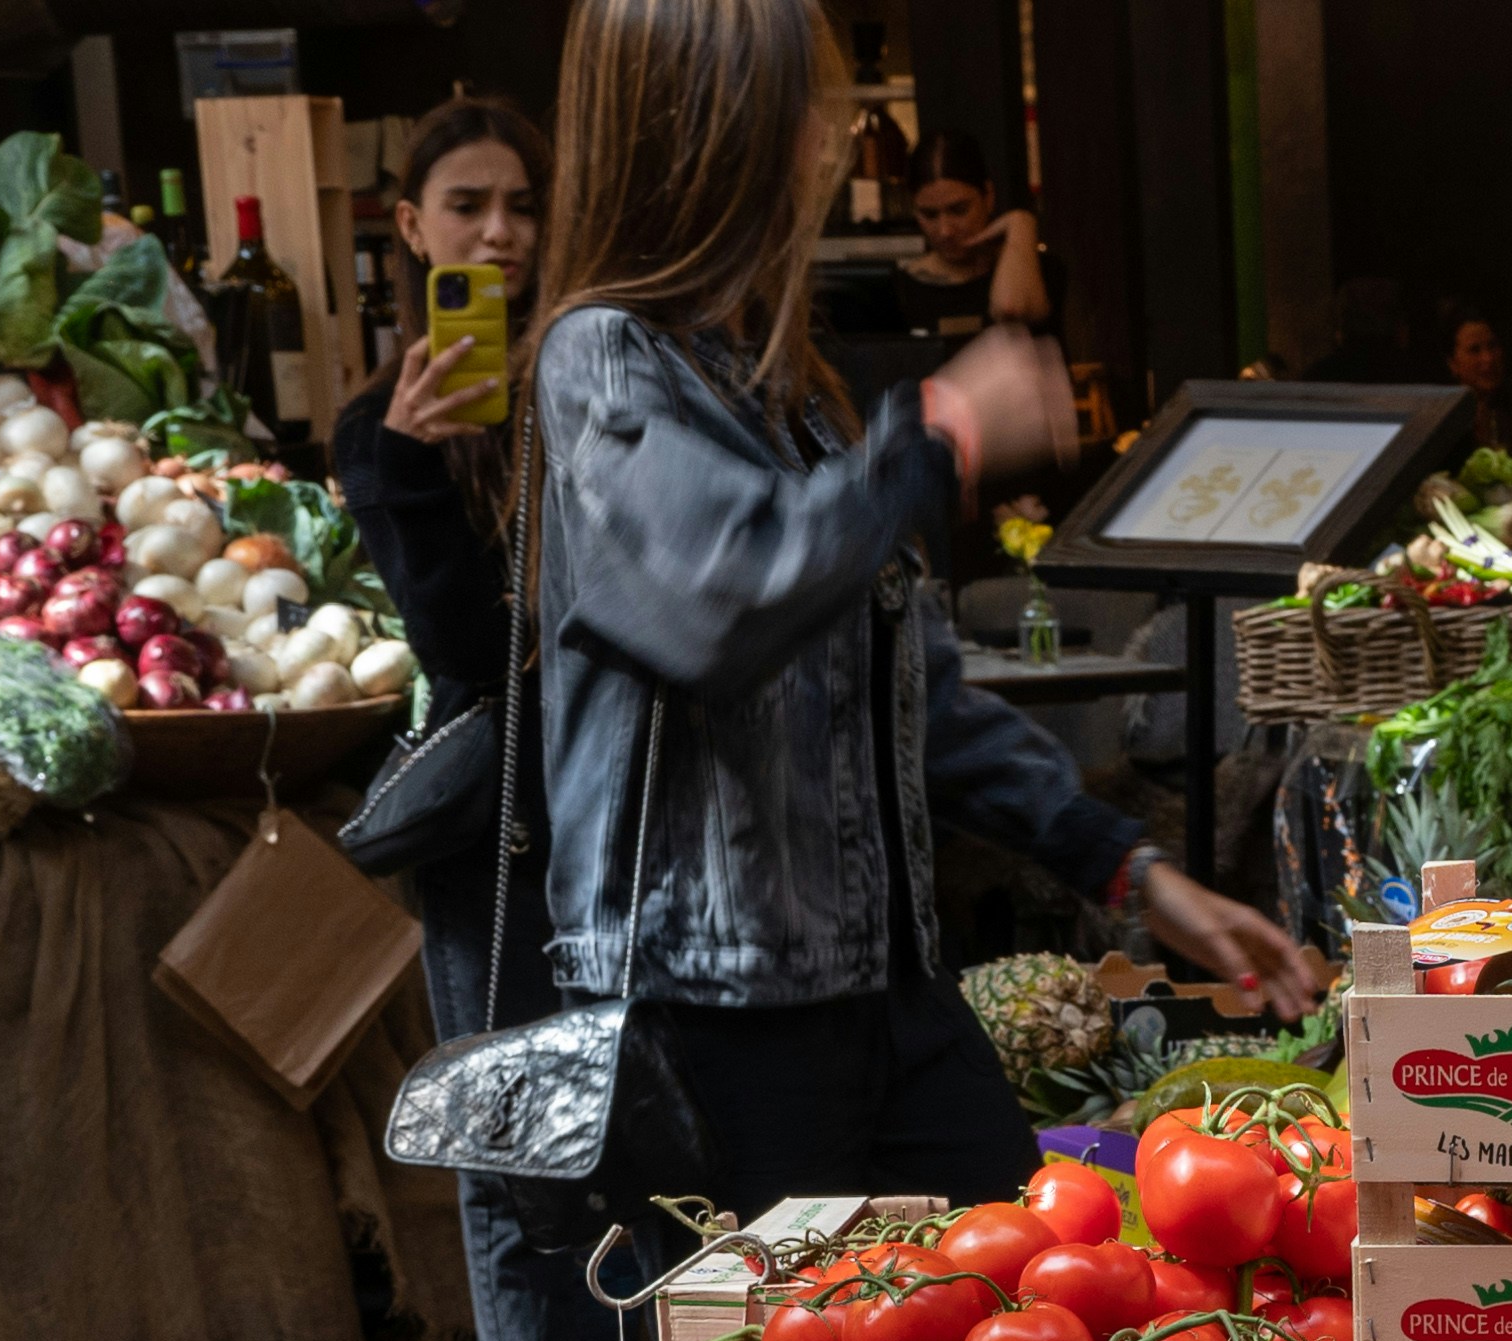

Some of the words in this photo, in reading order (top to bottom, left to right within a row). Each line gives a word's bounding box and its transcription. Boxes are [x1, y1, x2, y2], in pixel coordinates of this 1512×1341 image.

[1401, 1064, 1482, 1088] PRINCE
[1487, 1068, 1509, 1087] de
[1438, 1131, 1472, 1164] LES
[1409, 1314, 1488, 1337] PRINCE
